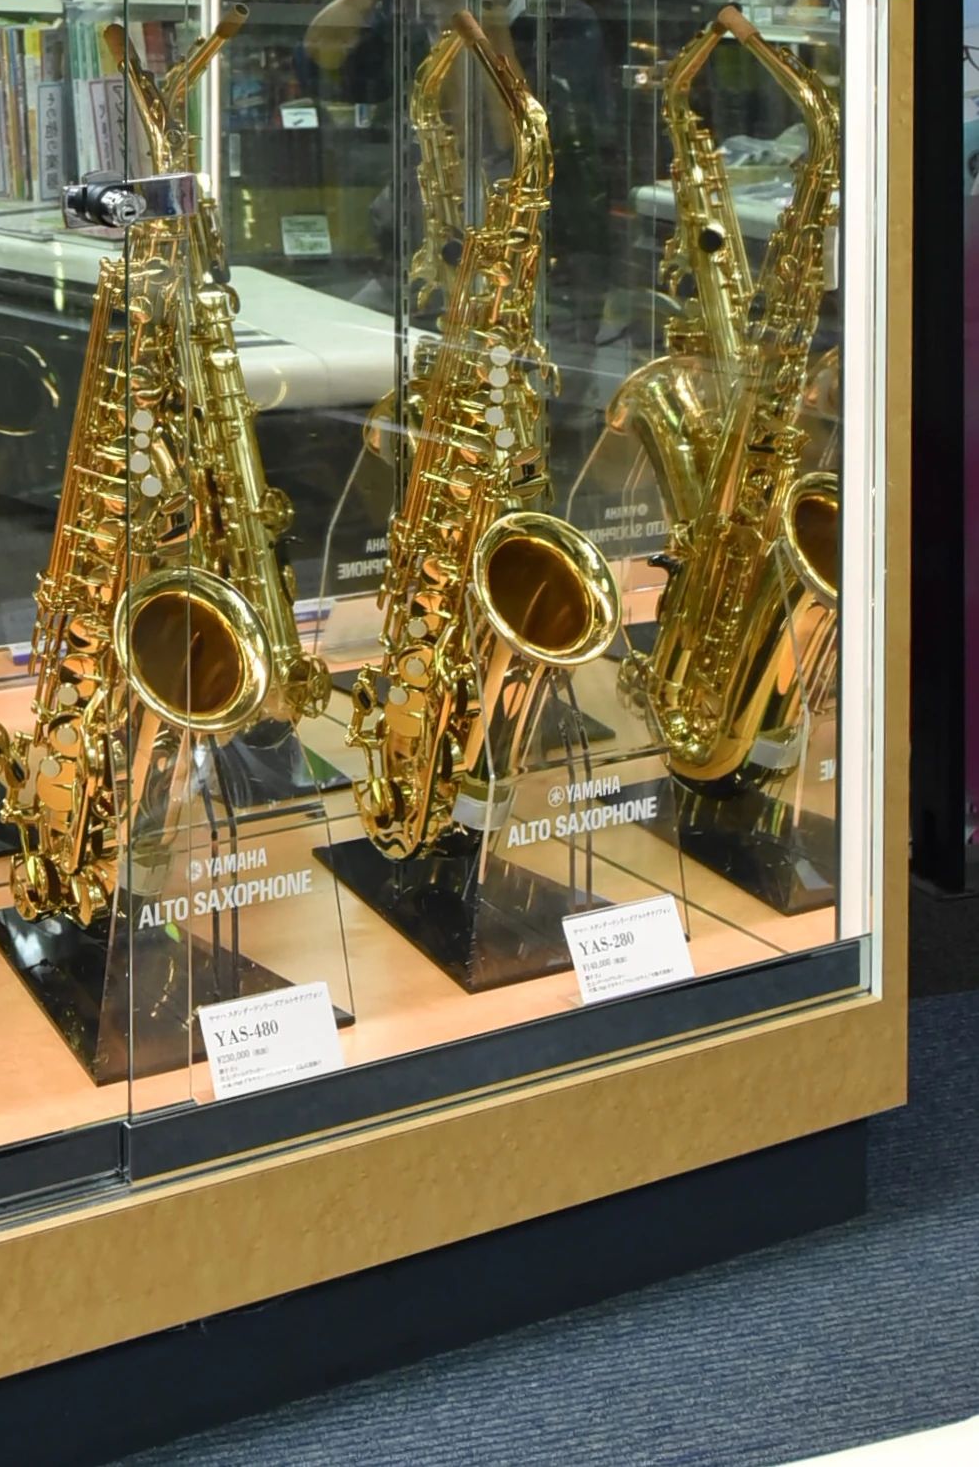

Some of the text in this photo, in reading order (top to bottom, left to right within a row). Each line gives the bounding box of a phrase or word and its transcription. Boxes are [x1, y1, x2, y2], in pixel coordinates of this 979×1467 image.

[563, 775, 621, 803] YAMAHA
[507, 795, 658, 849] ALTO SAXOPHONE
[204, 848, 267, 879] YAMAHA
[138, 869, 313, 930] ALTO SAXOPHONE
[578, 930, 635, 956] YAS-280
[214, 1019, 279, 1048] YAS-480
